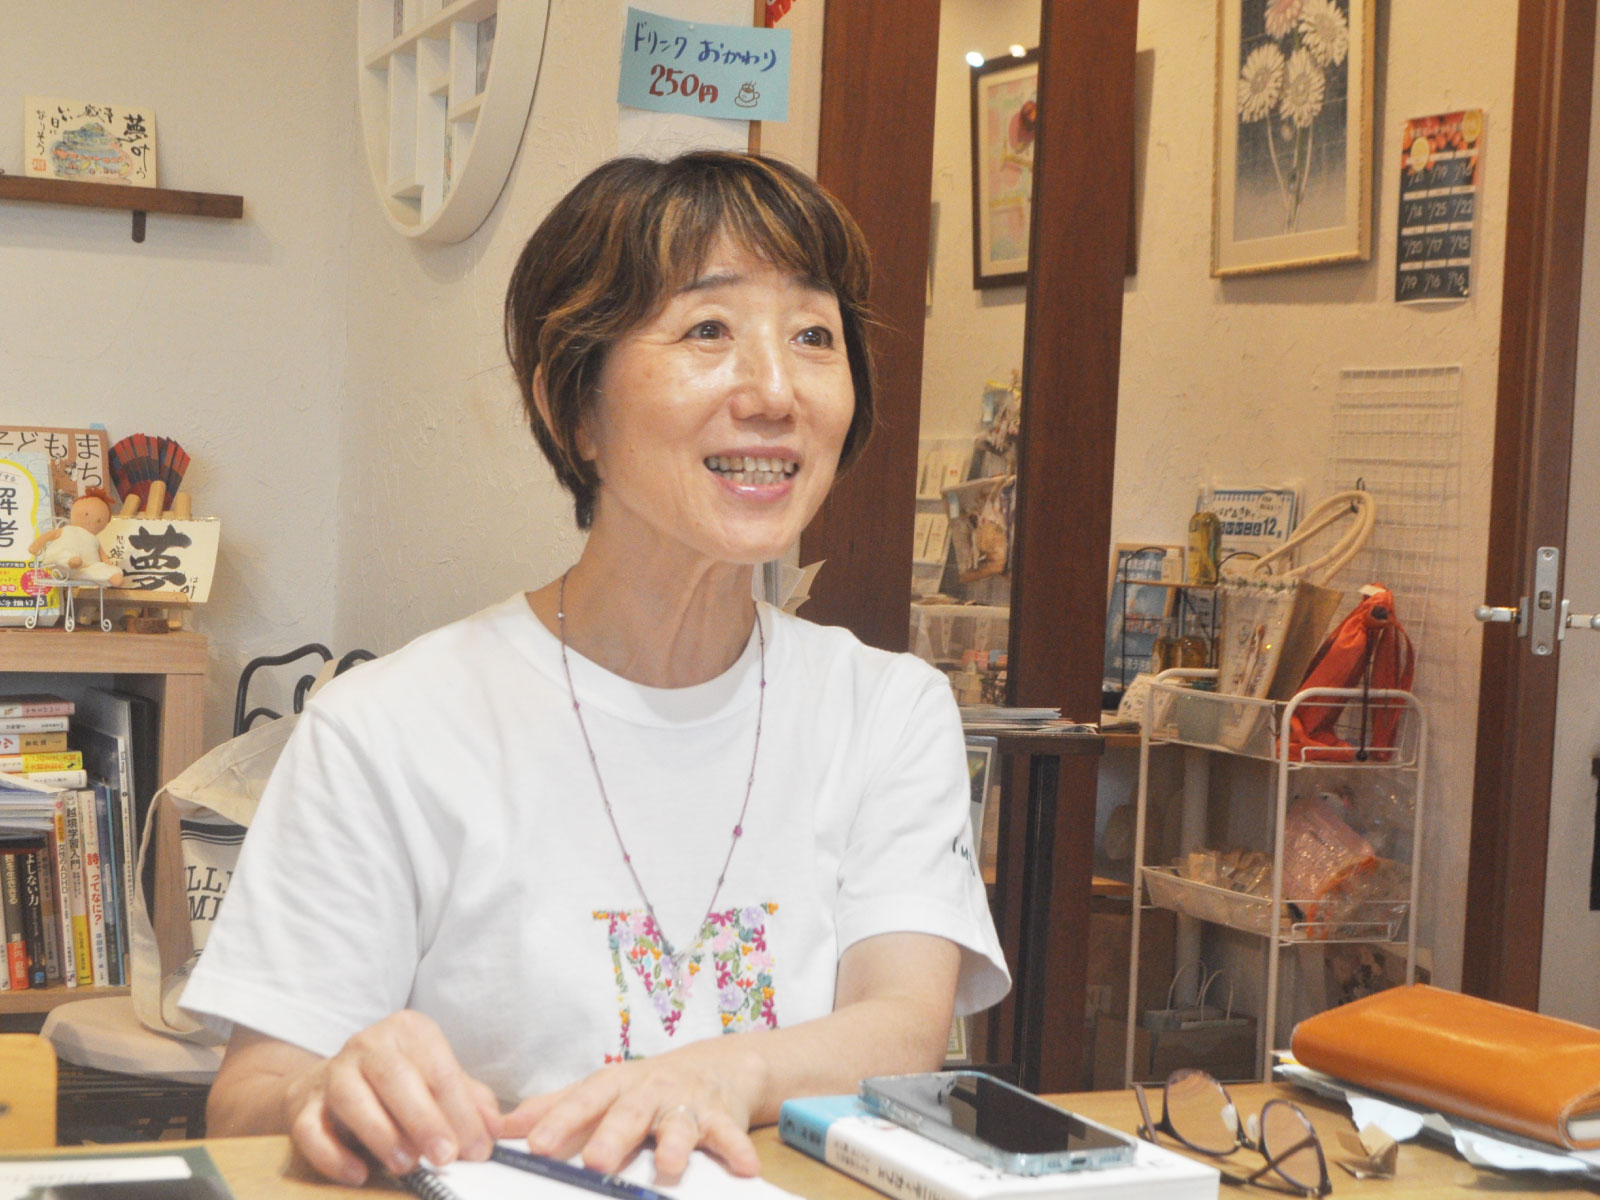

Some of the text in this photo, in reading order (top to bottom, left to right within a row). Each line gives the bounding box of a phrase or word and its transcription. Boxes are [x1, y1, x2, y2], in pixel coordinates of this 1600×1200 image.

[634, 21, 778, 73] ドリンク おかわり
[648, 63, 719, 105] 250円
[75, 433, 103, 487] まち
[106, 523, 193, 591] 夢
[25, 853, 40, 907] よしない力
[592, 902, 780, 1064] M
